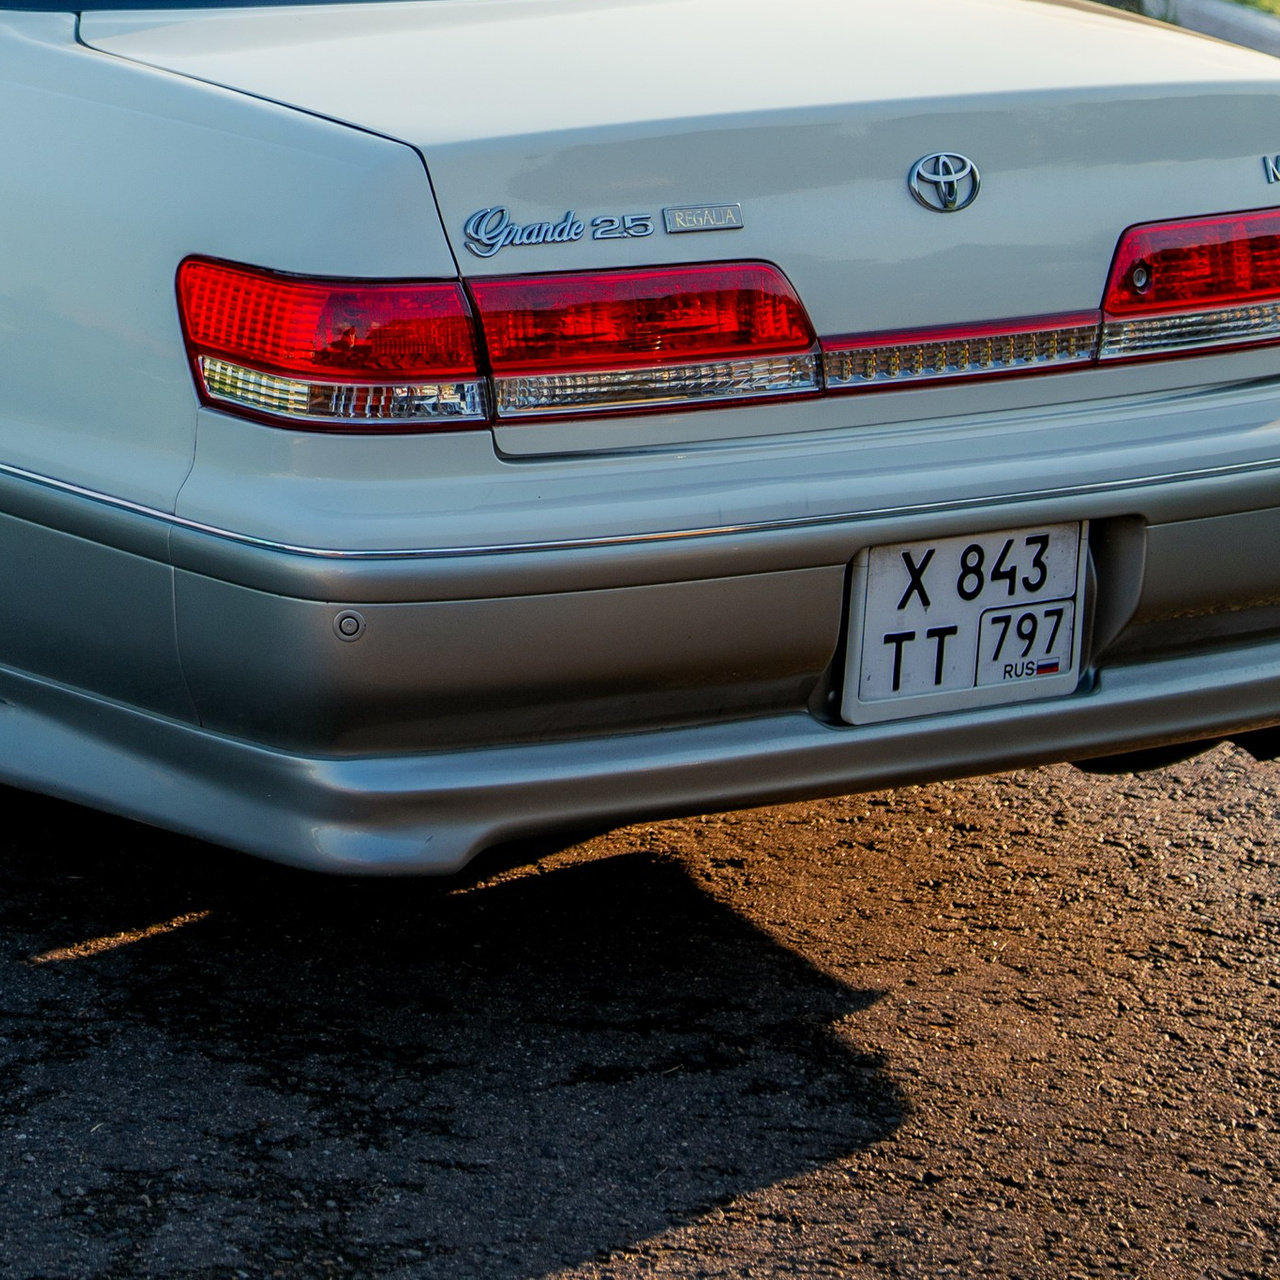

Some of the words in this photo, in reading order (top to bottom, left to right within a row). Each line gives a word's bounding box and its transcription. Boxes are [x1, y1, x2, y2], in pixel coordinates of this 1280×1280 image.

[464, 205, 585, 258] Grande
[674, 208, 737, 228] REGALIA
[896, 548, 936, 610] X
[956, 534, 1050, 600] 843
[883, 625, 958, 690] TT
[991, 608, 1064, 661] 797
[1003, 660, 1035, 679] RUS
